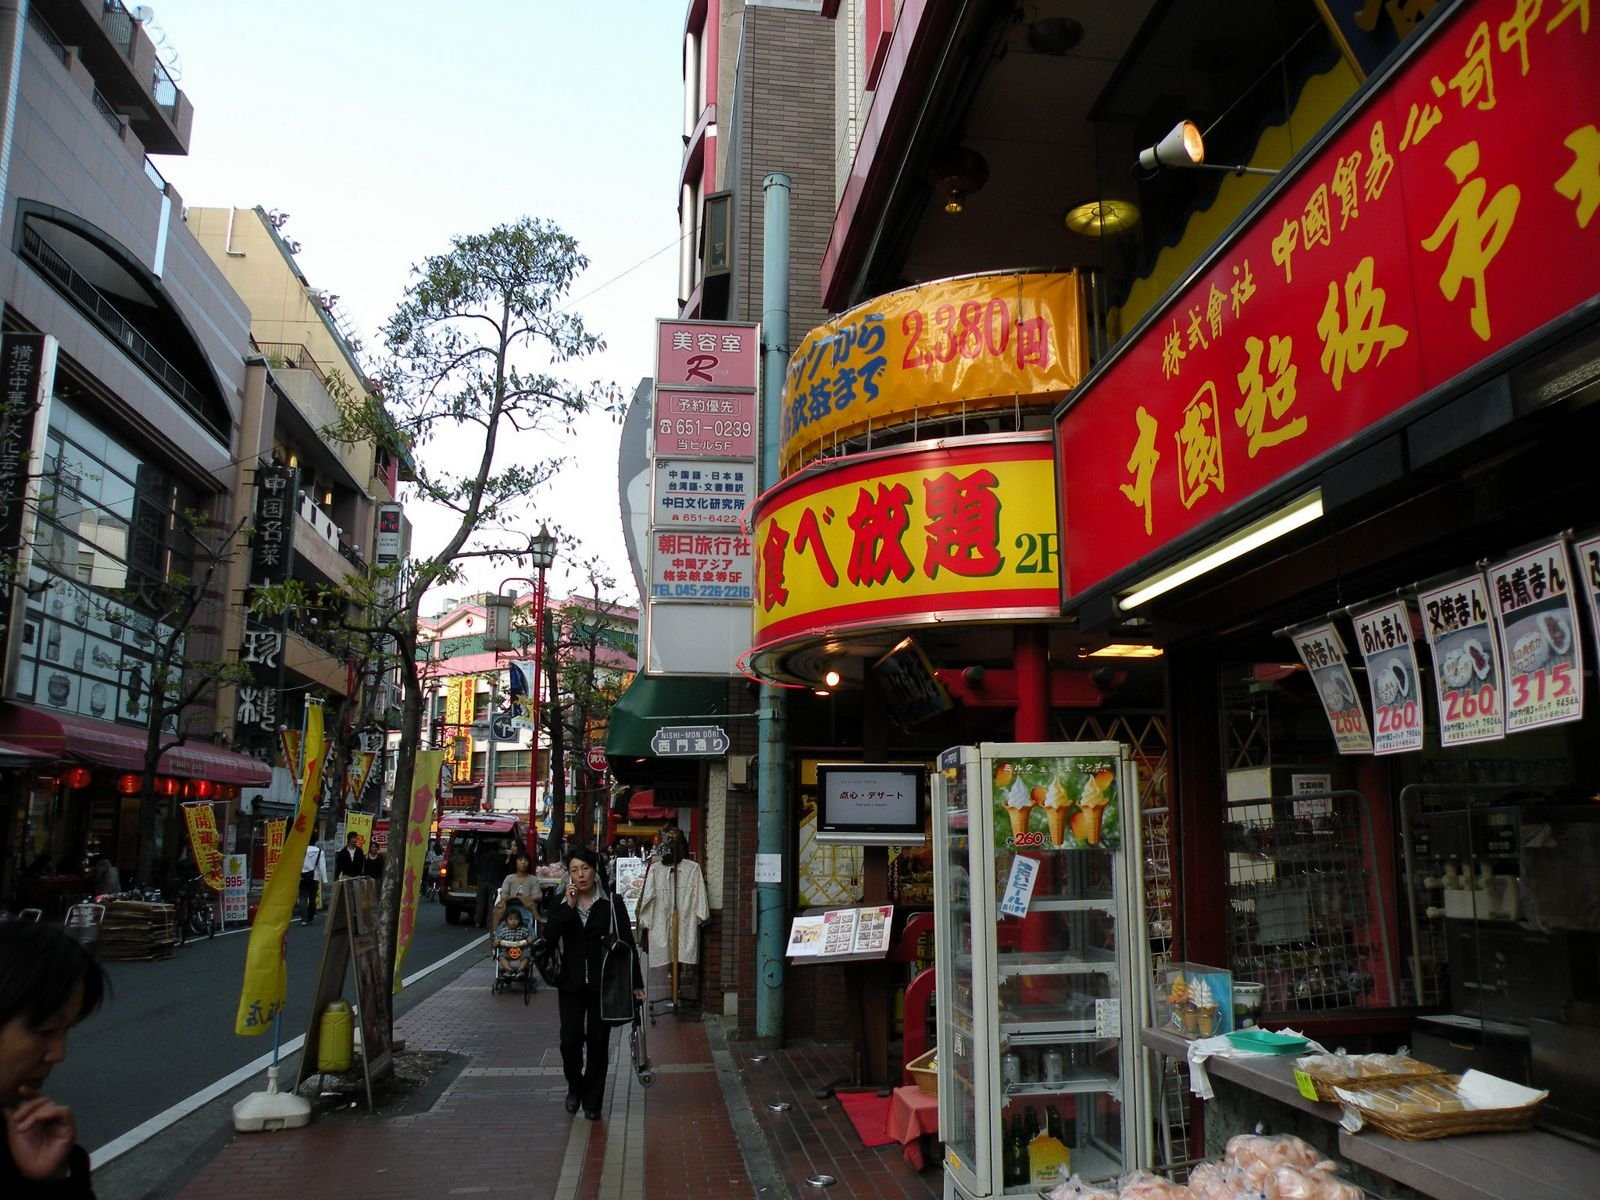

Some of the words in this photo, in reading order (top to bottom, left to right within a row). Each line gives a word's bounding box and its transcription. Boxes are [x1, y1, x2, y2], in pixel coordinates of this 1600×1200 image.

[672, 331, 742, 353] 美容室
[902, 297, 1049, 373] 2,380円
[685, 354, 719, 382] R
[678, 399, 734, 413] 予約優先
[662, 496, 746, 510] 中日文化研究所
[259, 473, 288, 568] 中国名菜
[657, 535, 751, 556] 朝日旅行社
[754, 468, 1005, 612] 食べ放題
[653, 583, 673, 597] TEL
[1495, 556, 1567, 614] 角煮まん
[1361, 612, 1408, 654] あんまん
[1301, 637, 1341, 669] 肉まん
[1512, 662, 1572, 708] 315
[1377, 700, 1417, 733] 260
[1444, 683, 1495, 721] 260
[657, 738, 723, 753] 西門通り
[1003, 763, 1033, 772] ミルク
[1076, 762, 1112, 770] マンゴー
[839, 791, 904, 800] 点心・デザート
